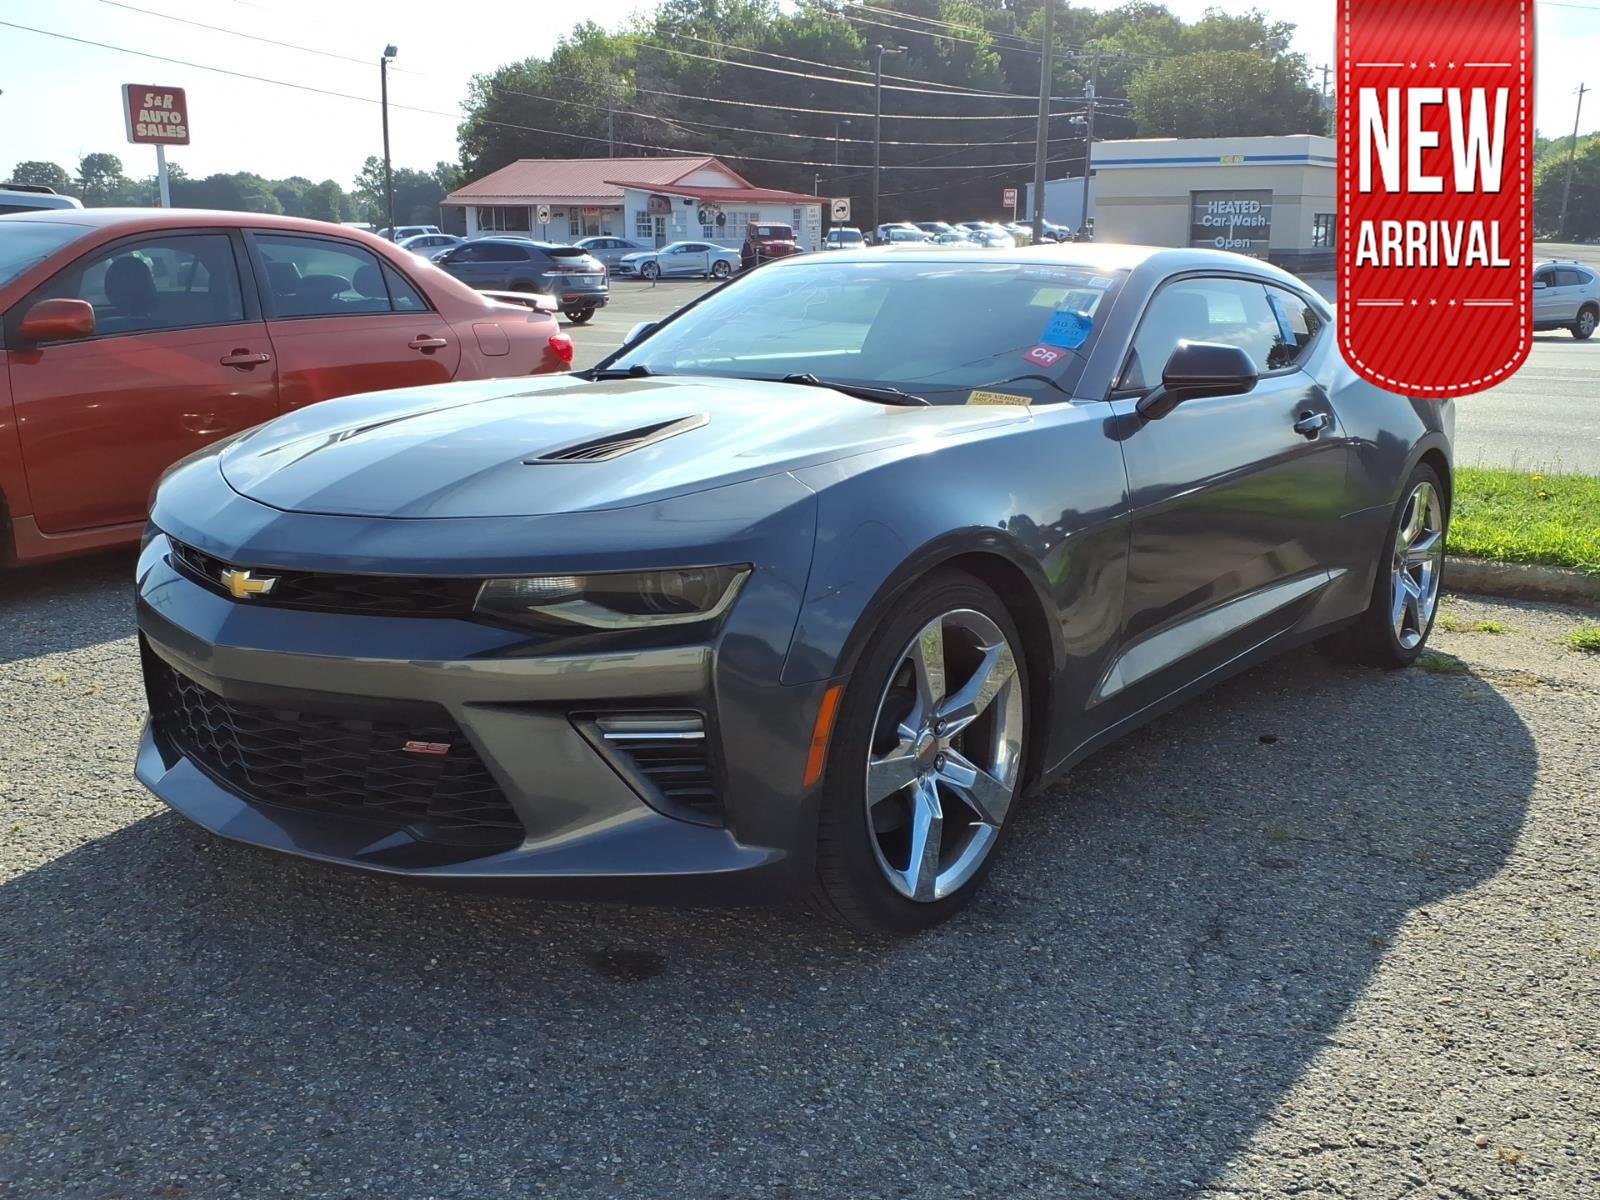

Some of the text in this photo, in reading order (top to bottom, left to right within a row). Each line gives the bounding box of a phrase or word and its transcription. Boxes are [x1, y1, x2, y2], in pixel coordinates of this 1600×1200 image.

[143, 93, 173, 108] S&R
[139, 109, 182, 124] AUTO
[136, 124, 186, 138] SALES
[1207, 200, 1261, 214] HEATED
[1202, 214, 1266, 227] Car Wash
[1214, 236, 1250, 250] Open
[1031, 347, 1057, 362] CR
